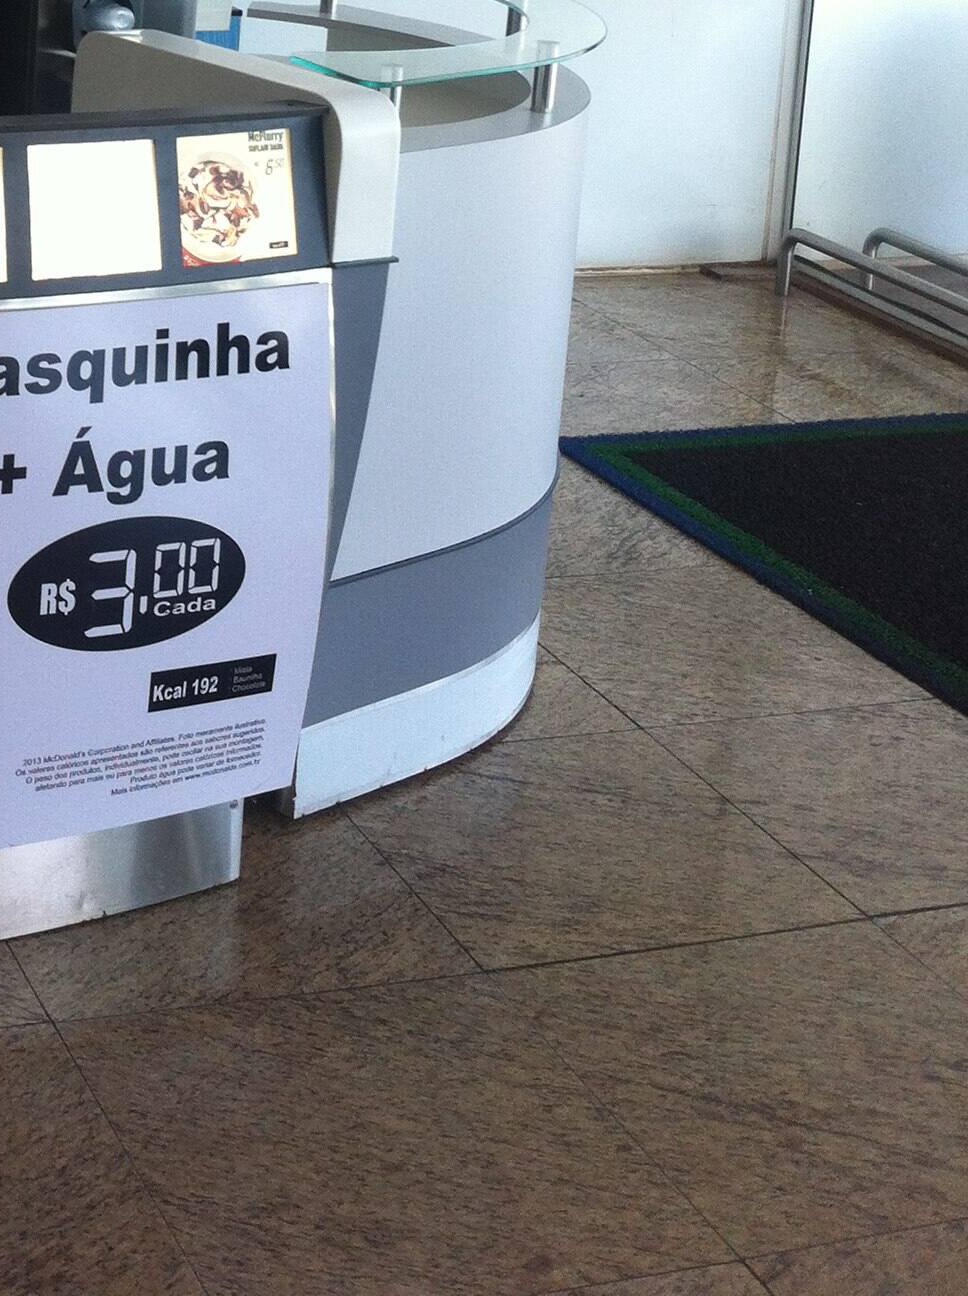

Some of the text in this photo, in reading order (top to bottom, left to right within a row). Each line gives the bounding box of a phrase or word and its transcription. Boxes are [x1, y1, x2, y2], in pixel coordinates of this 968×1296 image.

[247, 130, 284, 143] McFlurry
[52, 426, 230, 505] Água
[39, 578, 76, 616] R$
[153, 597, 216, 617] Cada
[152, 676, 219, 702] Kcal 192
[232, 680, 267, 693] Chocolate
[15, 767, 27, 777] Os
[28, 764, 55, 774] valores
[56, 759, 89, 771] calóricos
[90, 751, 138, 765] apresentados
[154, 742, 189, 753] referentes
[23, 756, 42, 767] 2013
[43, 750, 86, 764] McDonald's
[87, 743, 130, 757] Corporation
[130, 740, 145, 749] and
[178, 732, 194, 741] Foto
[195, 725, 233, 737] meramente
[25, 776, 33, 785] O
[34, 774, 53, 784] peso
[54, 771, 68, 780] dos
[162, 752, 180, 762] pode
[35, 780, 67, 792] afetando
[68, 778, 85, 788] para
[86, 774, 104, 783] mais
[116, 770, 132, 779] para
[134, 765, 157, 775] menos
[169, 757, 193, 767] valores
[130, 770, 158, 784] Produto
[177, 765, 194, 775] pode
[111, 787, 128, 796] Mais
[129, 778, 171, 793] informações
[172, 776, 183, 785] em
